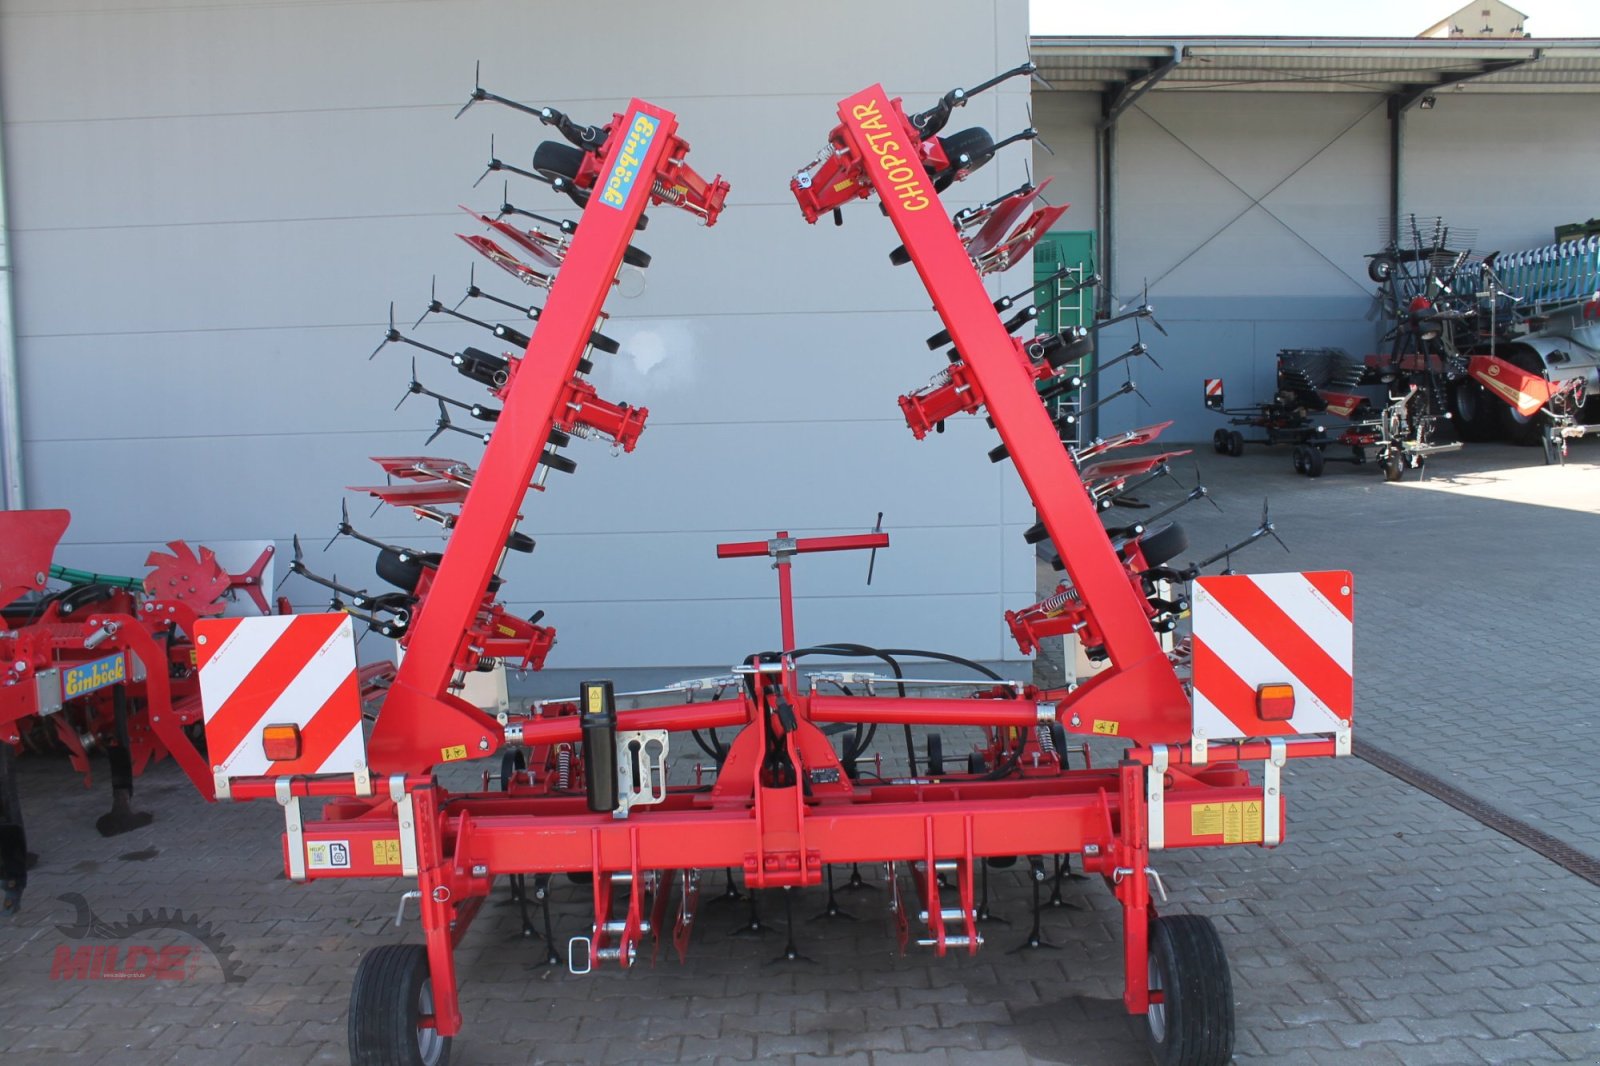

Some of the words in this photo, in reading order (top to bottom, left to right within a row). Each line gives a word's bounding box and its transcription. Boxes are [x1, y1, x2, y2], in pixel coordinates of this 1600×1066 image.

[604, 116, 654, 205] Einböck
[853, 99, 930, 211] CHOPSTAR
[66, 656, 124, 695] Einböck
